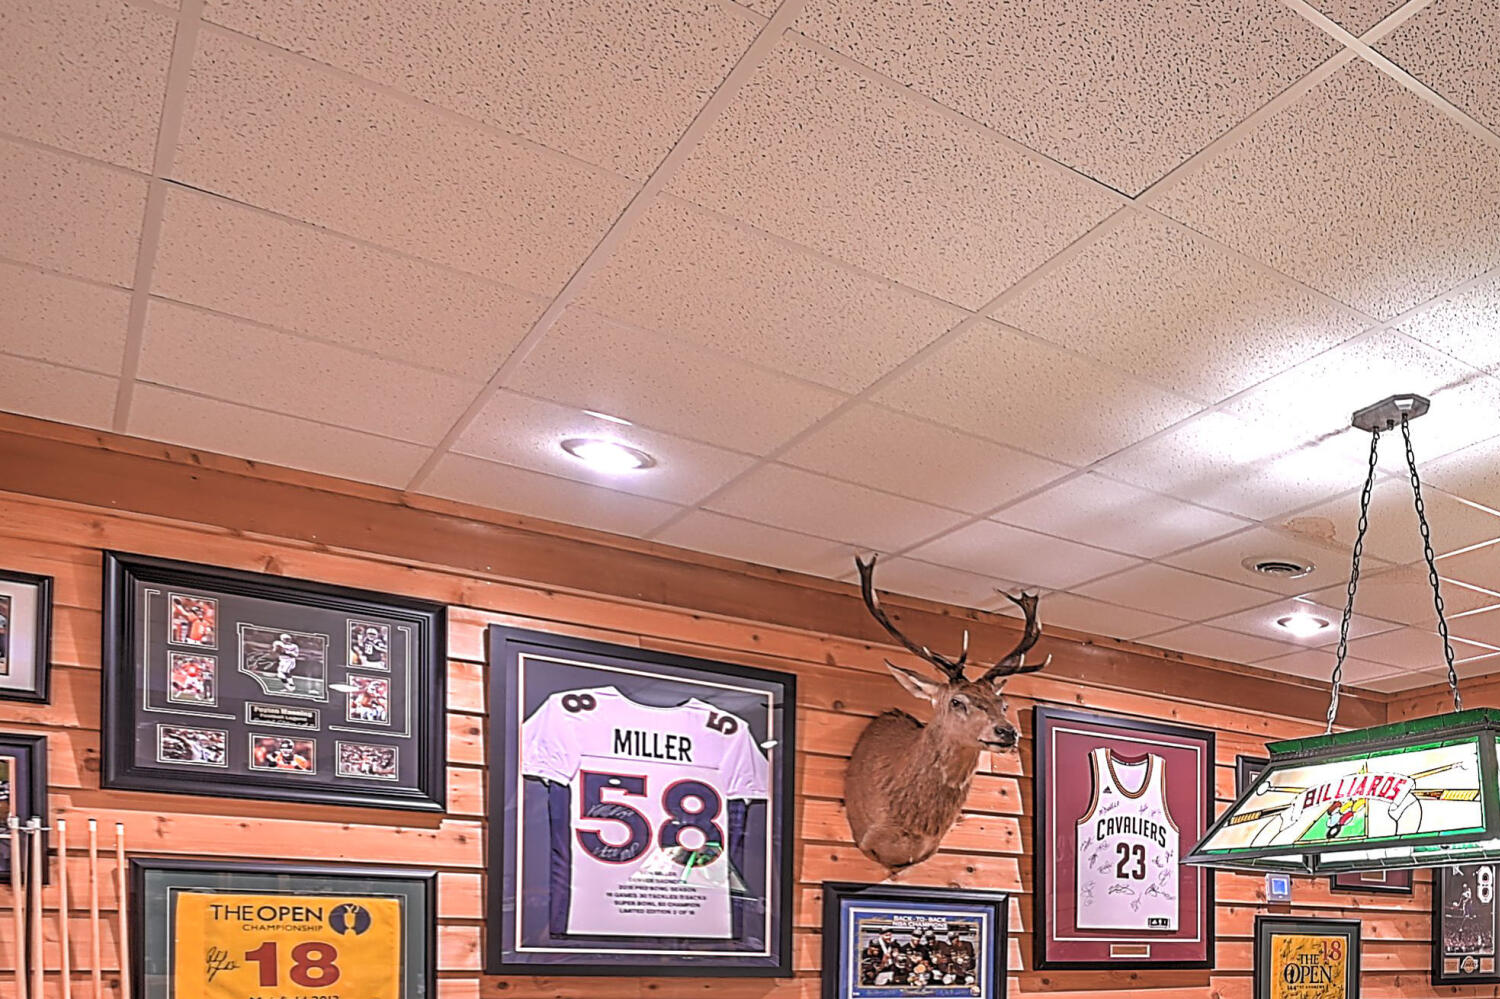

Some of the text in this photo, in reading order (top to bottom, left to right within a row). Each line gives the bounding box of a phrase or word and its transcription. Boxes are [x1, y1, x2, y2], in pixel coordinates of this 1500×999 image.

[614, 729, 692, 762] MILLER
[1302, 776, 1407, 809] BILLIARDS
[575, 769, 725, 868] 58
[1096, 816, 1166, 848] CAVALIERS
[1116, 842, 1146, 880] 23
[210, 904, 323, 922] THE OPEN
[242, 924, 323, 932] CHAMPIONSHIP
[245, 942, 340, 988] 18
[1298, 954, 1320, 965] THE
[1322, 940, 1342, 961] 18
[1284, 963, 1332, 984] OPEN
